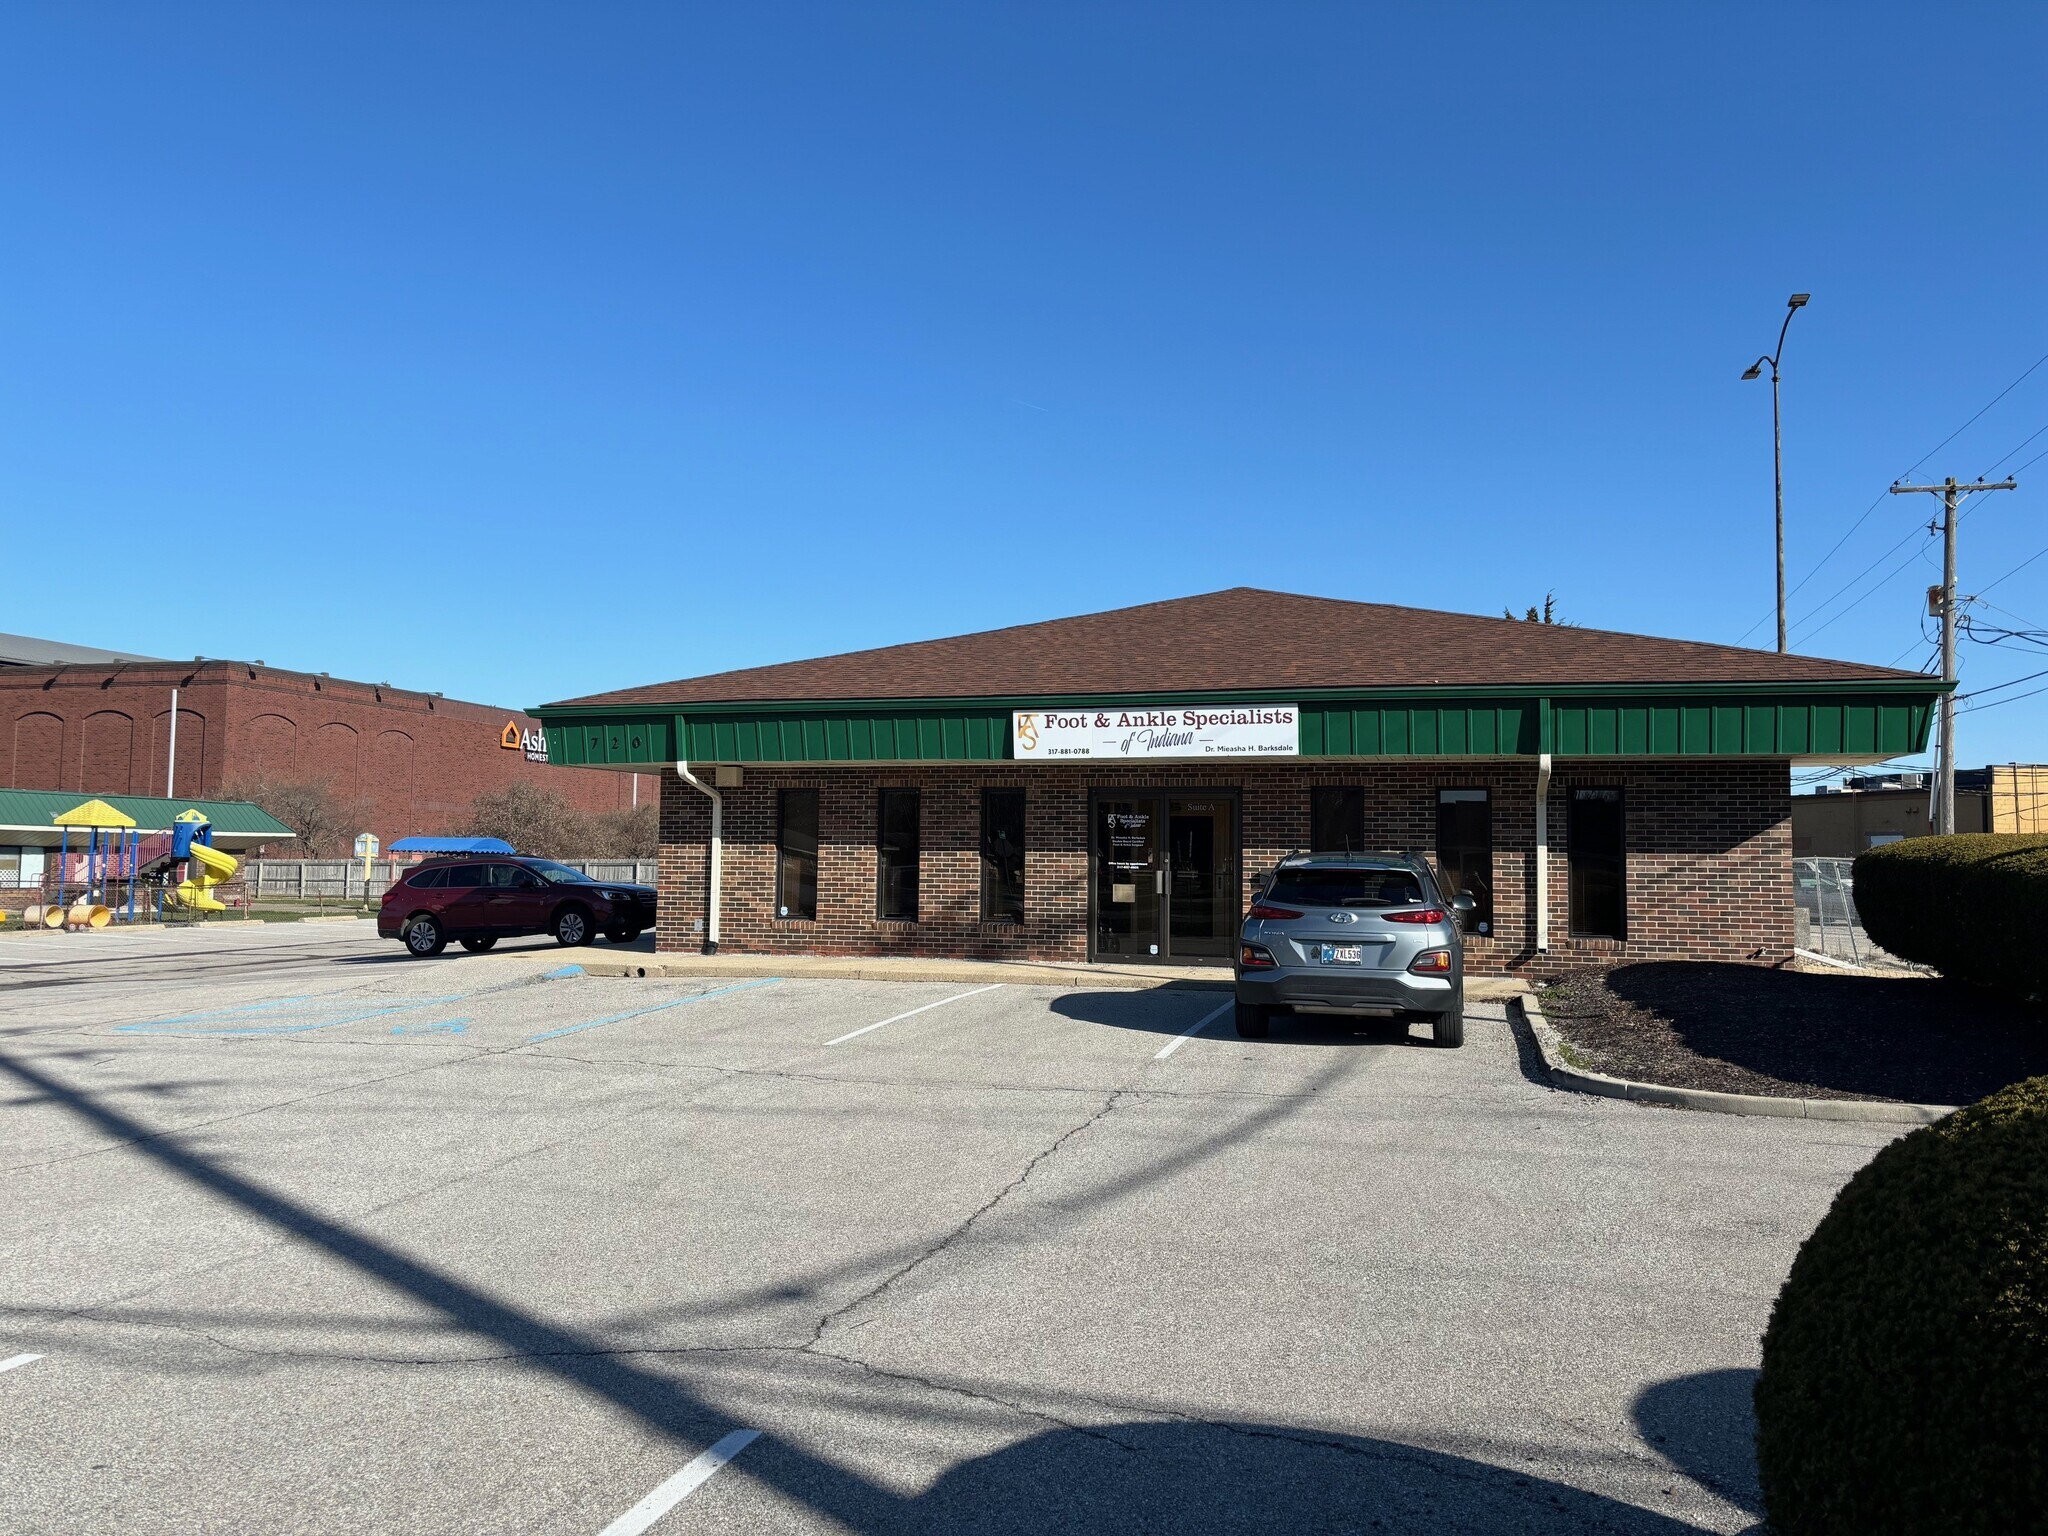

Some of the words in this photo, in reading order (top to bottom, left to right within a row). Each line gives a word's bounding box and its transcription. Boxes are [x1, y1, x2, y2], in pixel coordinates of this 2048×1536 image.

[1044, 713, 1088, 729] Foot
[1094, 712, 1111, 728] &
[1116, 711, 1177, 728] Ankle
[1182, 708, 1294, 730] Specialists
[519, 727, 548, 753] Ash
[1120, 731, 1137, 755] of
[1136, 727, 1194, 752] Indiana
[1205, 745, 1216, 753] Dr.
[1248, 744, 1257, 752] H.
[1258, 744, 1294, 752] Barksdale
[1187, 803, 1207, 811] Suite
[1209, 803, 1215, 811] A
[1335, 949, 1361, 960] ZXL536
